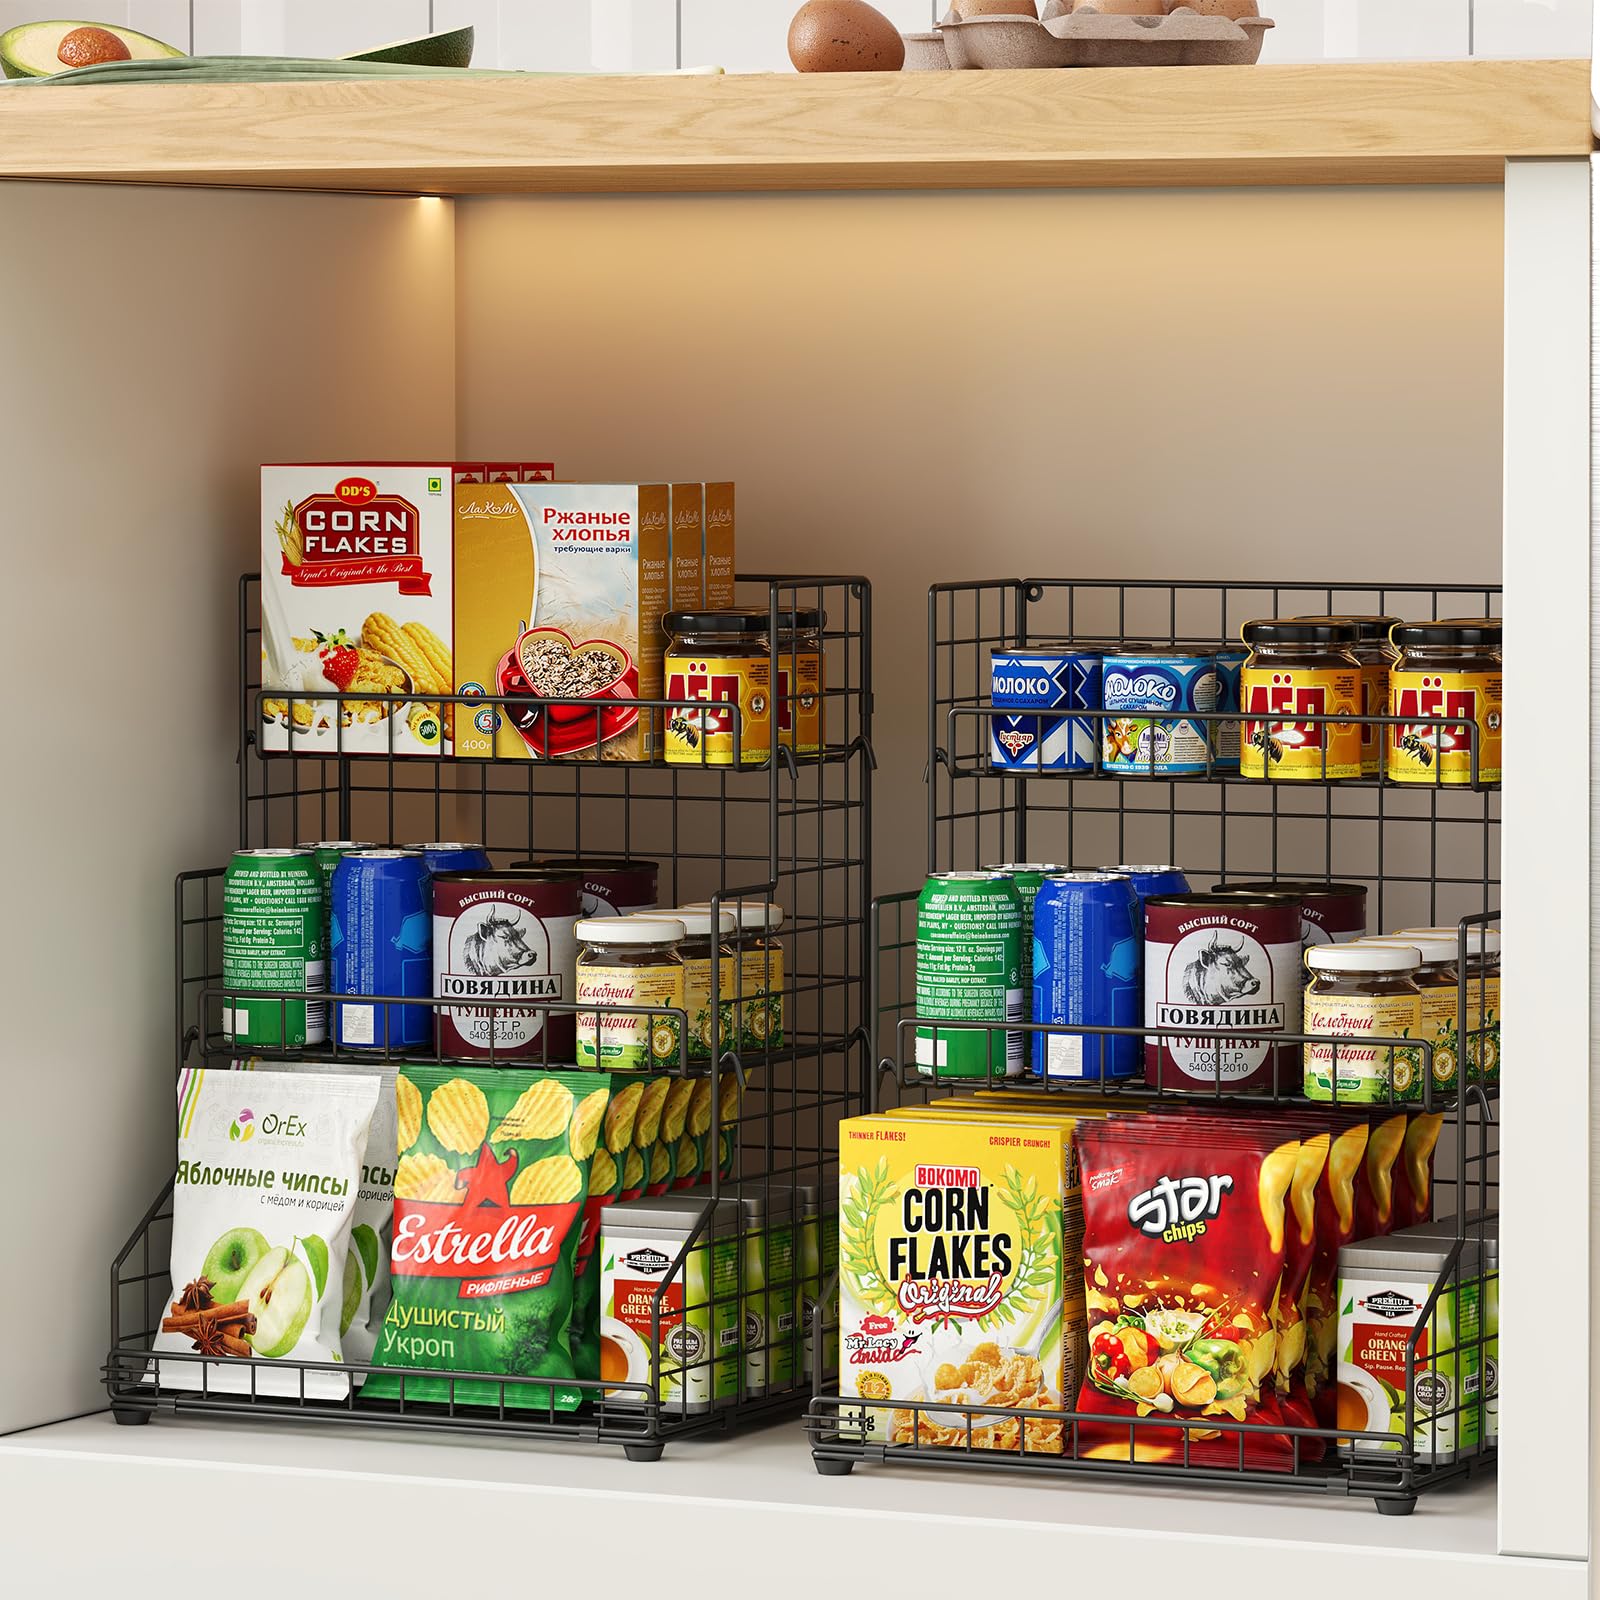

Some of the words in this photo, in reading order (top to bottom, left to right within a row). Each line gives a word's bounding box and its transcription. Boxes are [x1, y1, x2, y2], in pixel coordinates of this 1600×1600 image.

[341, 486, 370, 497] DD'S
[305, 510, 407, 532] CORN
[543, 508, 631, 526] Ржаные
[552, 526, 630, 542] хлопья
[305, 536, 407, 554] FLAKES
[553, 545, 604, 554] требующие
[642, 559, 665, 570] Ржаные
[676, 556, 699, 568] Ржаные
[709, 555, 731, 566] Ржаные
[295, 567, 328, 582] Nepal's
[329, 566, 366, 581] Original
[375, 564, 390, 574] the
[391, 562, 413, 574] Best
[993, 676, 1050, 694] МОЛОКО
[1128, 698, 1163, 707] СГУЩЕННОЕ
[266, 879, 296, 887] AMSTERDAM,
[584, 881, 612, 897] СОРТ
[458, 889, 505, 908] ВЫСШИЙ
[507, 891, 535, 908] СОРТ
[948, 894, 958, 902] AND
[960, 894, 980, 902] BOTTLED
[1301, 905, 1325, 922] ОРТ
[275, 919, 294, 927] Servings
[954, 922, 984, 930] QUESTIONS?
[1177, 914, 1228, 934] ВЫСШИЙ
[1230, 916, 1259, 934] СОРТ
[976, 945, 995, 953] Servings
[974, 954, 993, 962] Calories
[951, 963, 969, 971] Protein
[444, 977, 557, 998] ГОВЯДИНА
[473, 1021, 508, 1032] ГОСТ
[512, 1021, 521, 1032] Р
[1160, 1008, 1280, 1030] ГОВЯДИНА
[1174, 1036, 1260, 1049] ТУШНАЯ
[1193, 1052, 1230, 1063] ГОСТ
[1234, 1052, 1243, 1063] Р
[262, 1113, 308, 1136] OrEx
[848, 1131, 874, 1140] THINNER
[875, 1130, 906, 1142] FLAKES!
[989, 1136, 1021, 1147] CRISPIER
[1023, 1138, 1051, 1149] CRUNCH!
[176, 1160, 275, 1188] Яблочные
[281, 1170, 349, 1196] чипсы
[917, 1166, 977, 1187] BOKOMO
[1091, 1174, 1121, 1191] smak
[260, 1196, 265, 1204] с
[266, 1195, 296, 1207] мёдом
[298, 1199, 304, 1207] и
[305, 1199, 345, 1212] корицей
[904, 1186, 989, 1233] CORN
[391, 1213, 554, 1265] Estrella
[1162, 1220, 1206, 1243] chips
[631, 1254, 666, 1262] PREMIUM
[890, 1233, 1012, 1281] FLAKES
[466, 1272, 543, 1295] РИФЛЕНЫЕ
[899, 1272, 1003, 1315] Original
[1371, 1297, 1410, 1306] PREMIUM
[384, 1298, 505, 1333] Душистый
[868, 1321, 888, 1330] Free
[383, 1327, 455, 1358] Укроп
[1368, 1338, 1408, 1351] ORANG
[1360, 1349, 1397, 1362] GREEN
[1400, 1351, 1420, 1362] TA
[864, 1381, 886, 1394] 12
